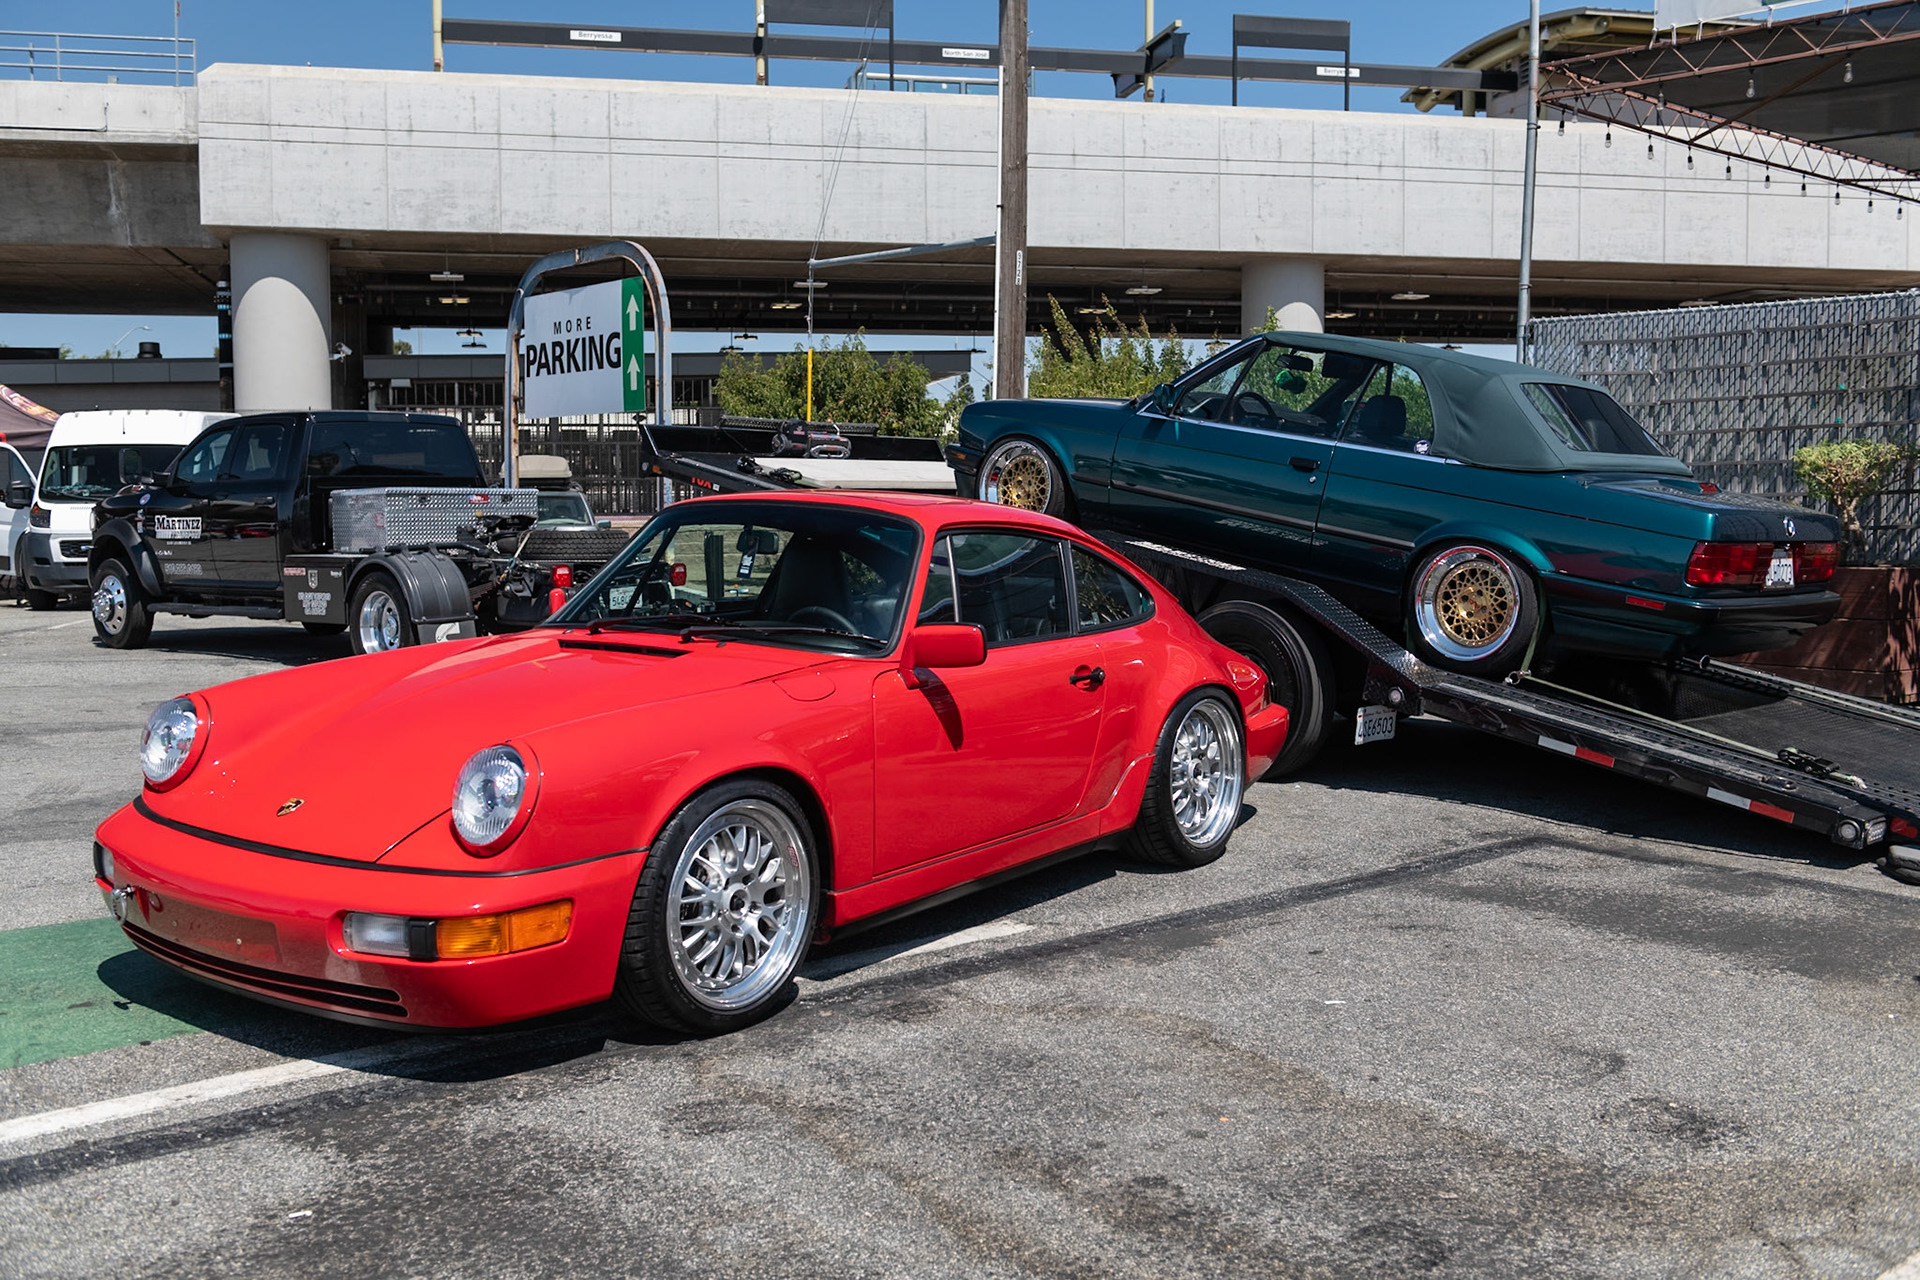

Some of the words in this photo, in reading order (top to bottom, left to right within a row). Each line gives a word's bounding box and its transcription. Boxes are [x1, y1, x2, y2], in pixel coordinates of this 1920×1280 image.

[578, 31, 613, 39] Berryessa
[553, 316, 591, 335] MORE
[526, 332, 621, 378] PARKING
[155, 516, 201, 530] MARTINEZ
